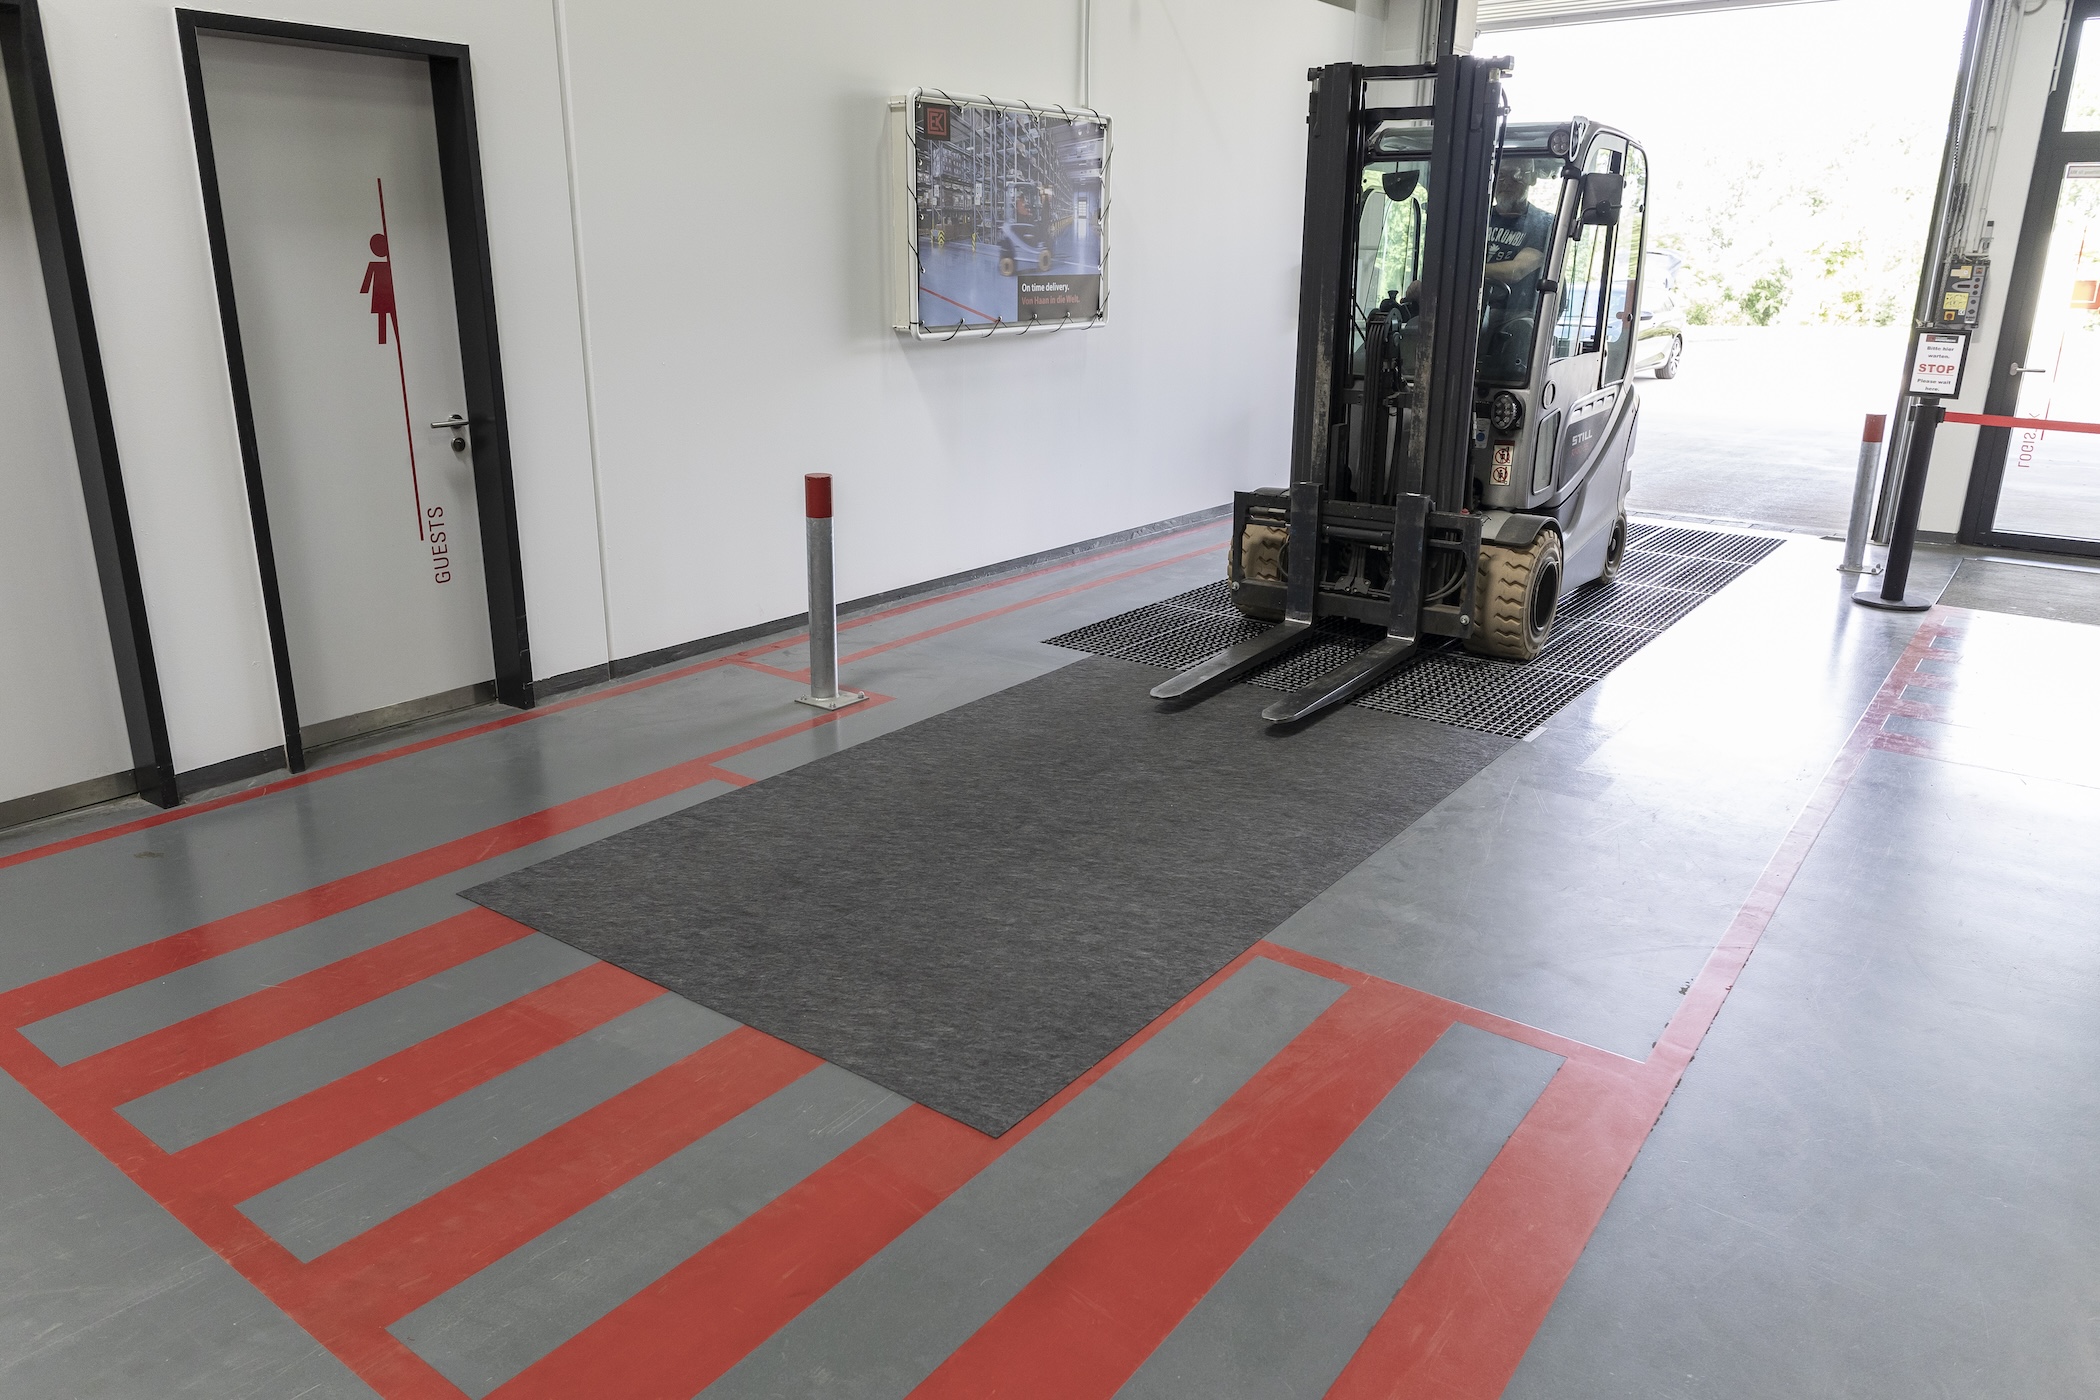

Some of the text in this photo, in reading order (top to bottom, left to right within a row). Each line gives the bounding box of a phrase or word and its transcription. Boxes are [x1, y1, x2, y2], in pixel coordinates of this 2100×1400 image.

[1021, 282, 1070, 293] On time delivery.
[1021, 296, 1034, 305] Von
[1034, 296, 1050, 305] Haan
[1050, 295, 1056, 304] in
[1057, 294, 1065, 304] die
[1918, 363, 1955, 373] STOP
[1571, 429, 1593, 446] STILL
[427, 506, 451, 584] GUESTS
